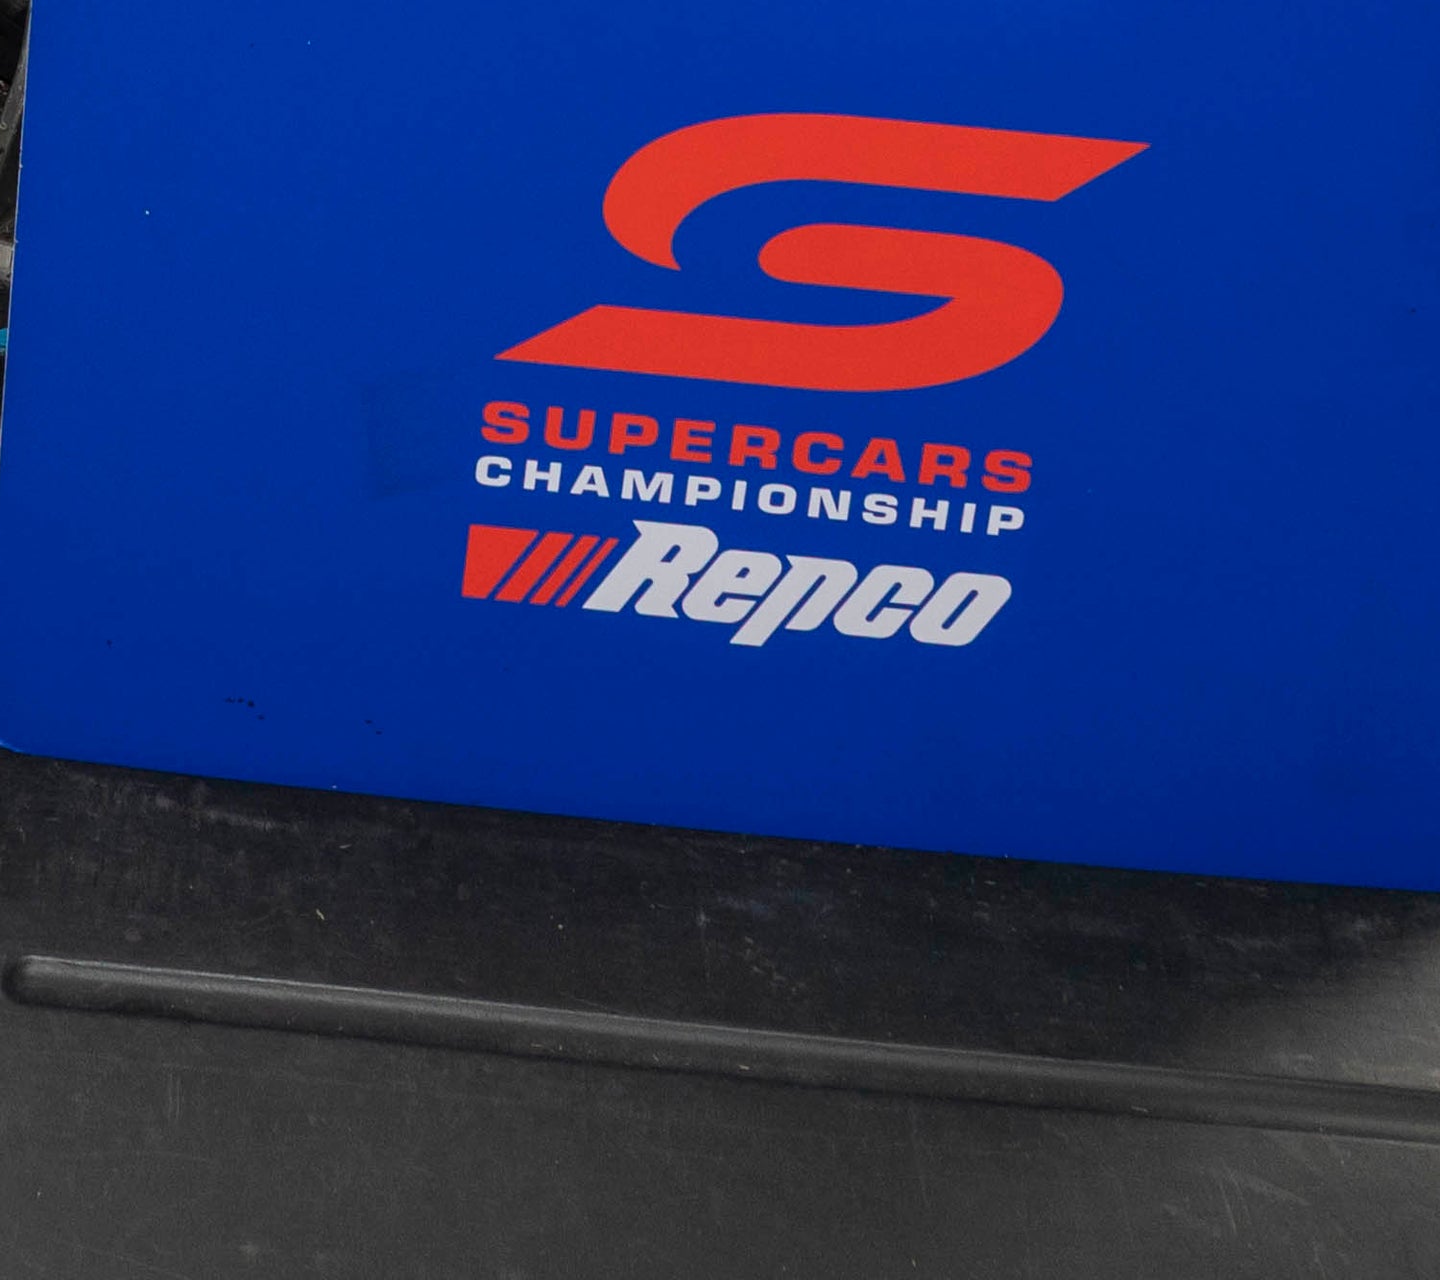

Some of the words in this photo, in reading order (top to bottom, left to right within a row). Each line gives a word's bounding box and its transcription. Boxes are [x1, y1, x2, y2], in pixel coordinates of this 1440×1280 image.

[479, 400, 1034, 494] SUPERCARS
[474, 454, 1027, 537] CHAMPIONSHIP
[582, 518, 1014, 648] Repco
